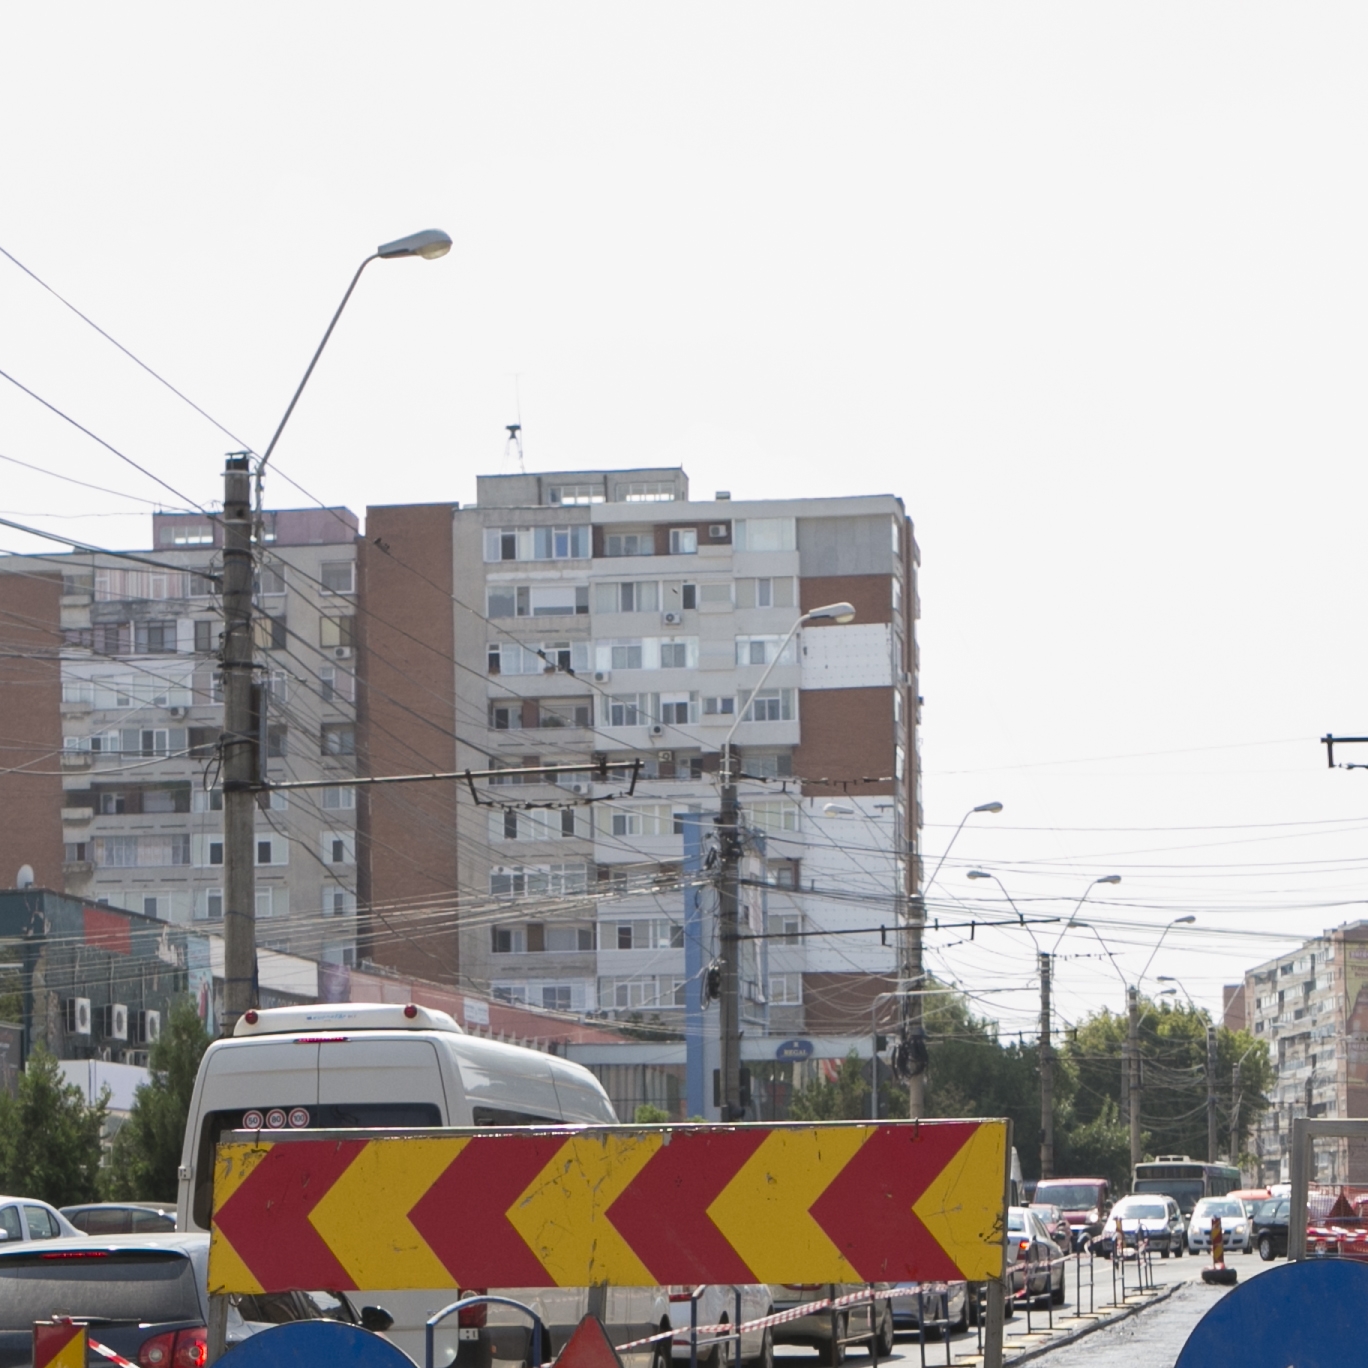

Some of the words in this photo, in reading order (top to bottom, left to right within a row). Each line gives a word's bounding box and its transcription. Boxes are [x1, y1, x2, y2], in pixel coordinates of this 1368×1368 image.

[248, 1117, 258, 1125] 50
[271, 1115, 281, 1123] 80
[293, 1114, 305, 1122] 100
